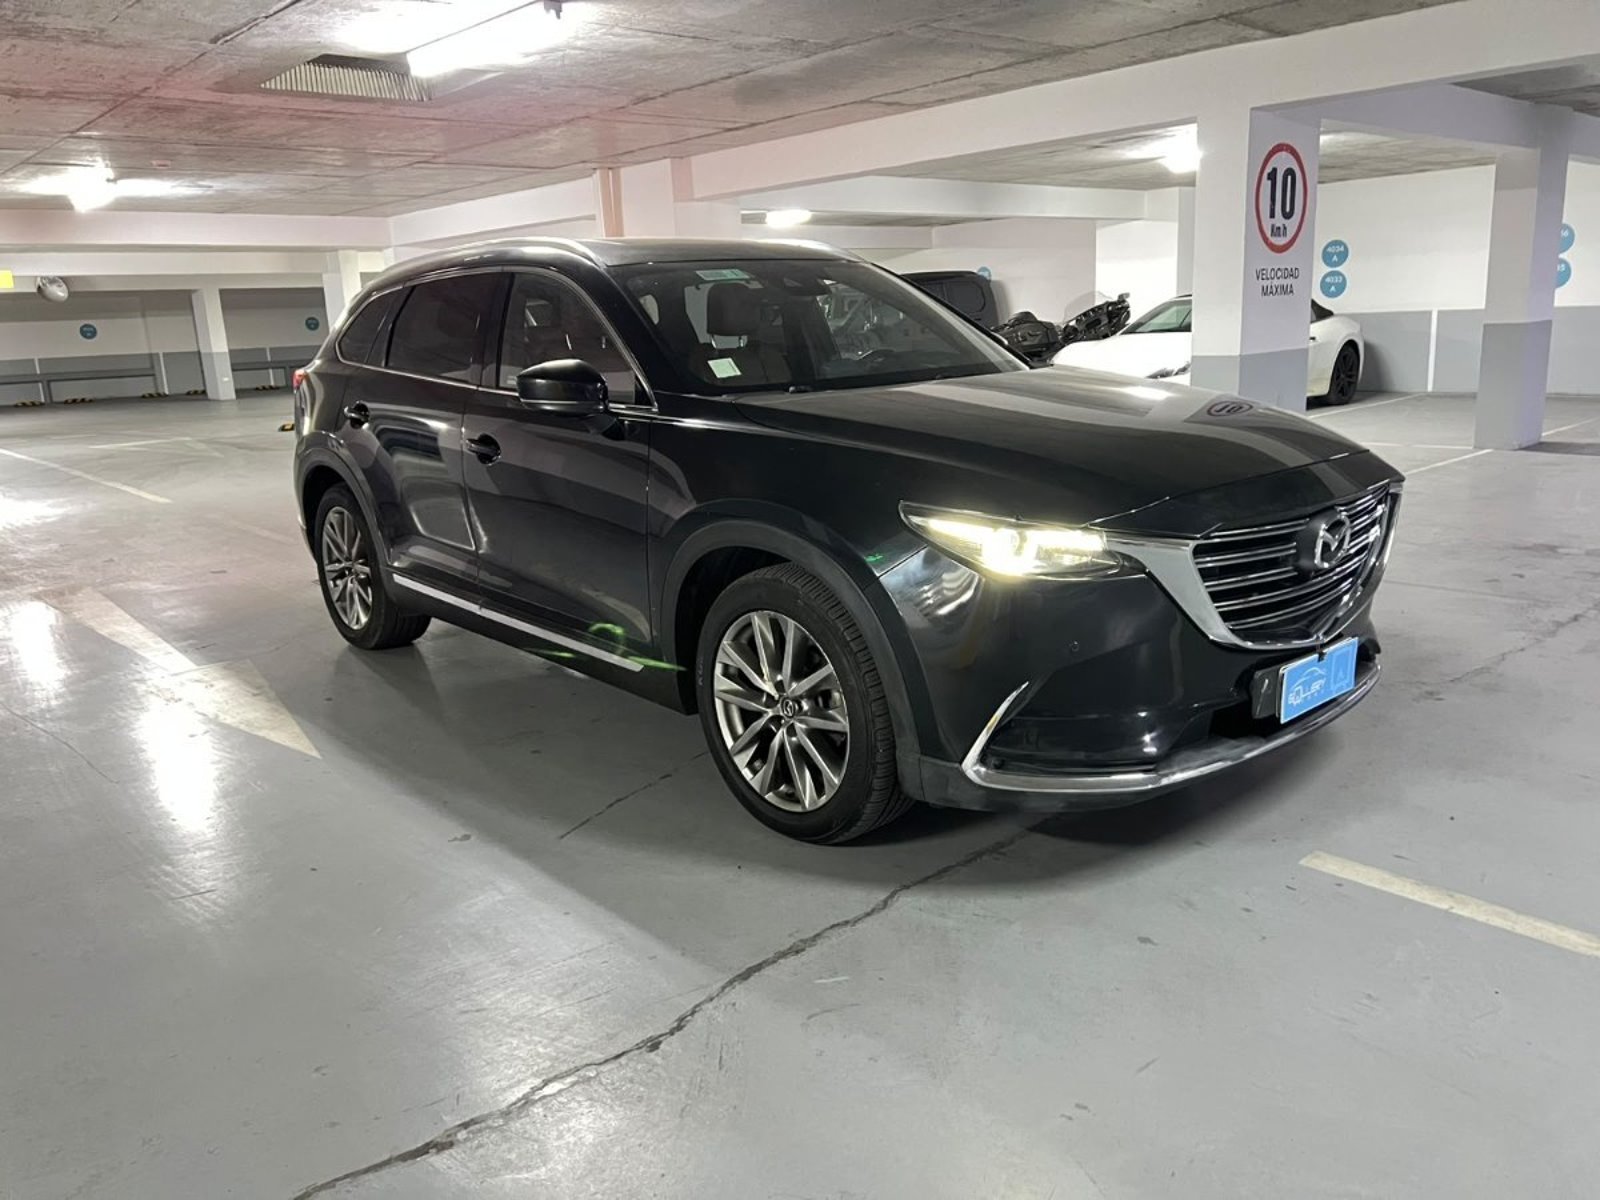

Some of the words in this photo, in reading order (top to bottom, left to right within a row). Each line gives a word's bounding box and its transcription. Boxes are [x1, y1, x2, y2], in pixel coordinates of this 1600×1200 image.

[1267, 167, 1297, 220] 10
[1255, 267, 1300, 281] VELOCIDAD
[1261, 281, 1294, 297] MÁXIMA
